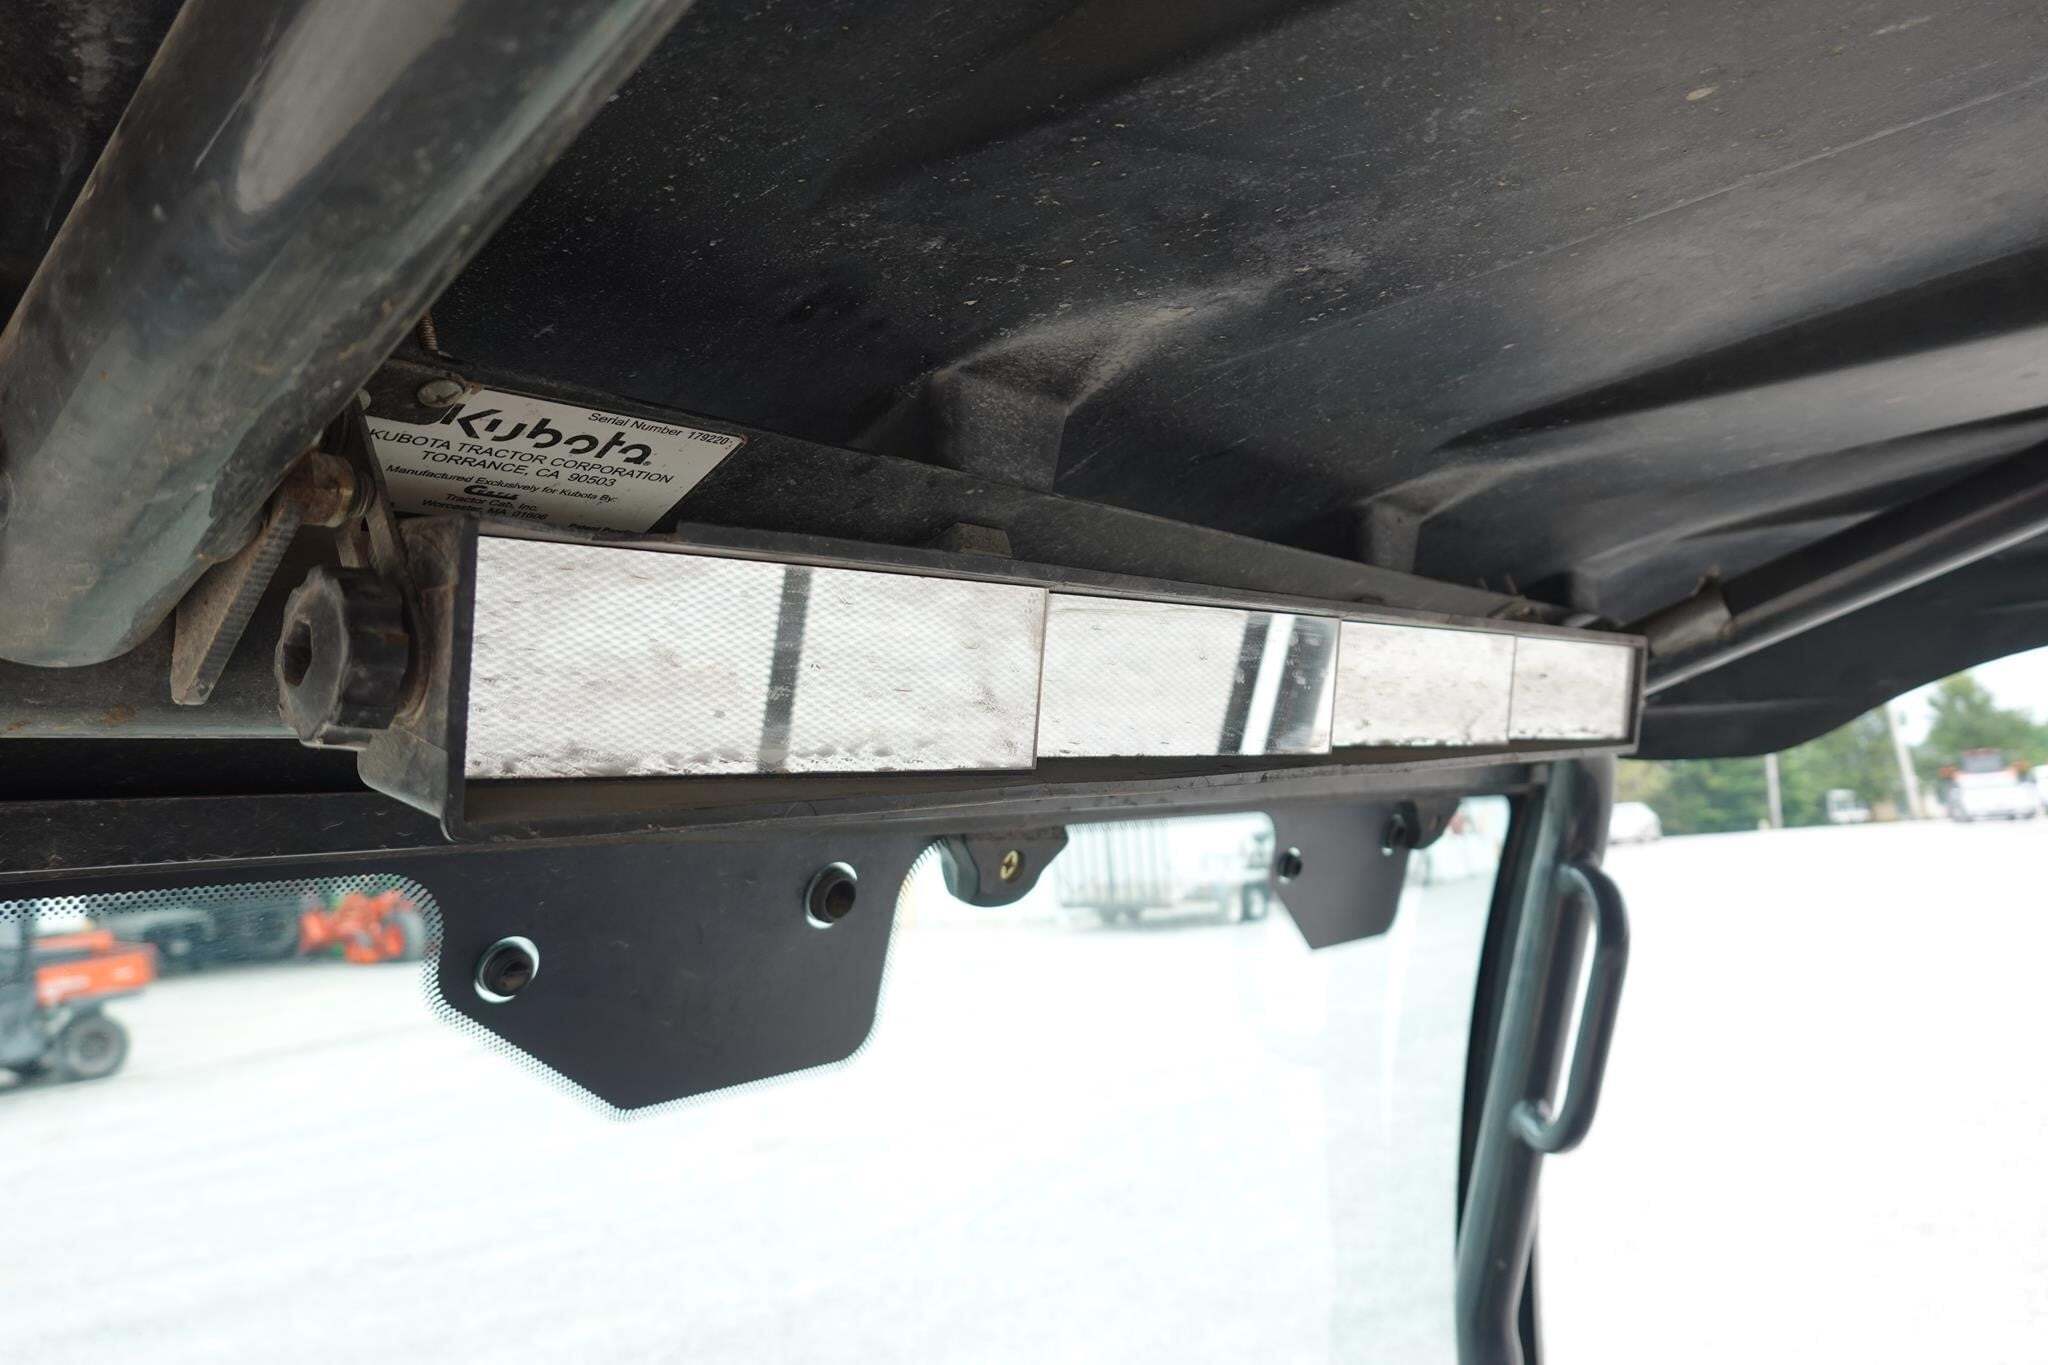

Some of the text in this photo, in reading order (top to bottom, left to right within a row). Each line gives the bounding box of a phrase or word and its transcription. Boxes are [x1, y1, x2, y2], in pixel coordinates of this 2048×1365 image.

[440, 403, 652, 465] Kubota
[588, 412, 627, 427] Serial
[631, 420, 683, 437] Number
[370, 428, 674, 484] KUBOTA TRACTOR CORPORATION
[421, 450, 617, 487] TORRANCE, CA 90503
[386, 464, 474, 484] Manufactured
[475, 477, 541, 493] Exclusively
[542, 486, 558, 495] for
[559, 488, 598, 500] Kubota
[446, 493, 488, 505] Tractor
